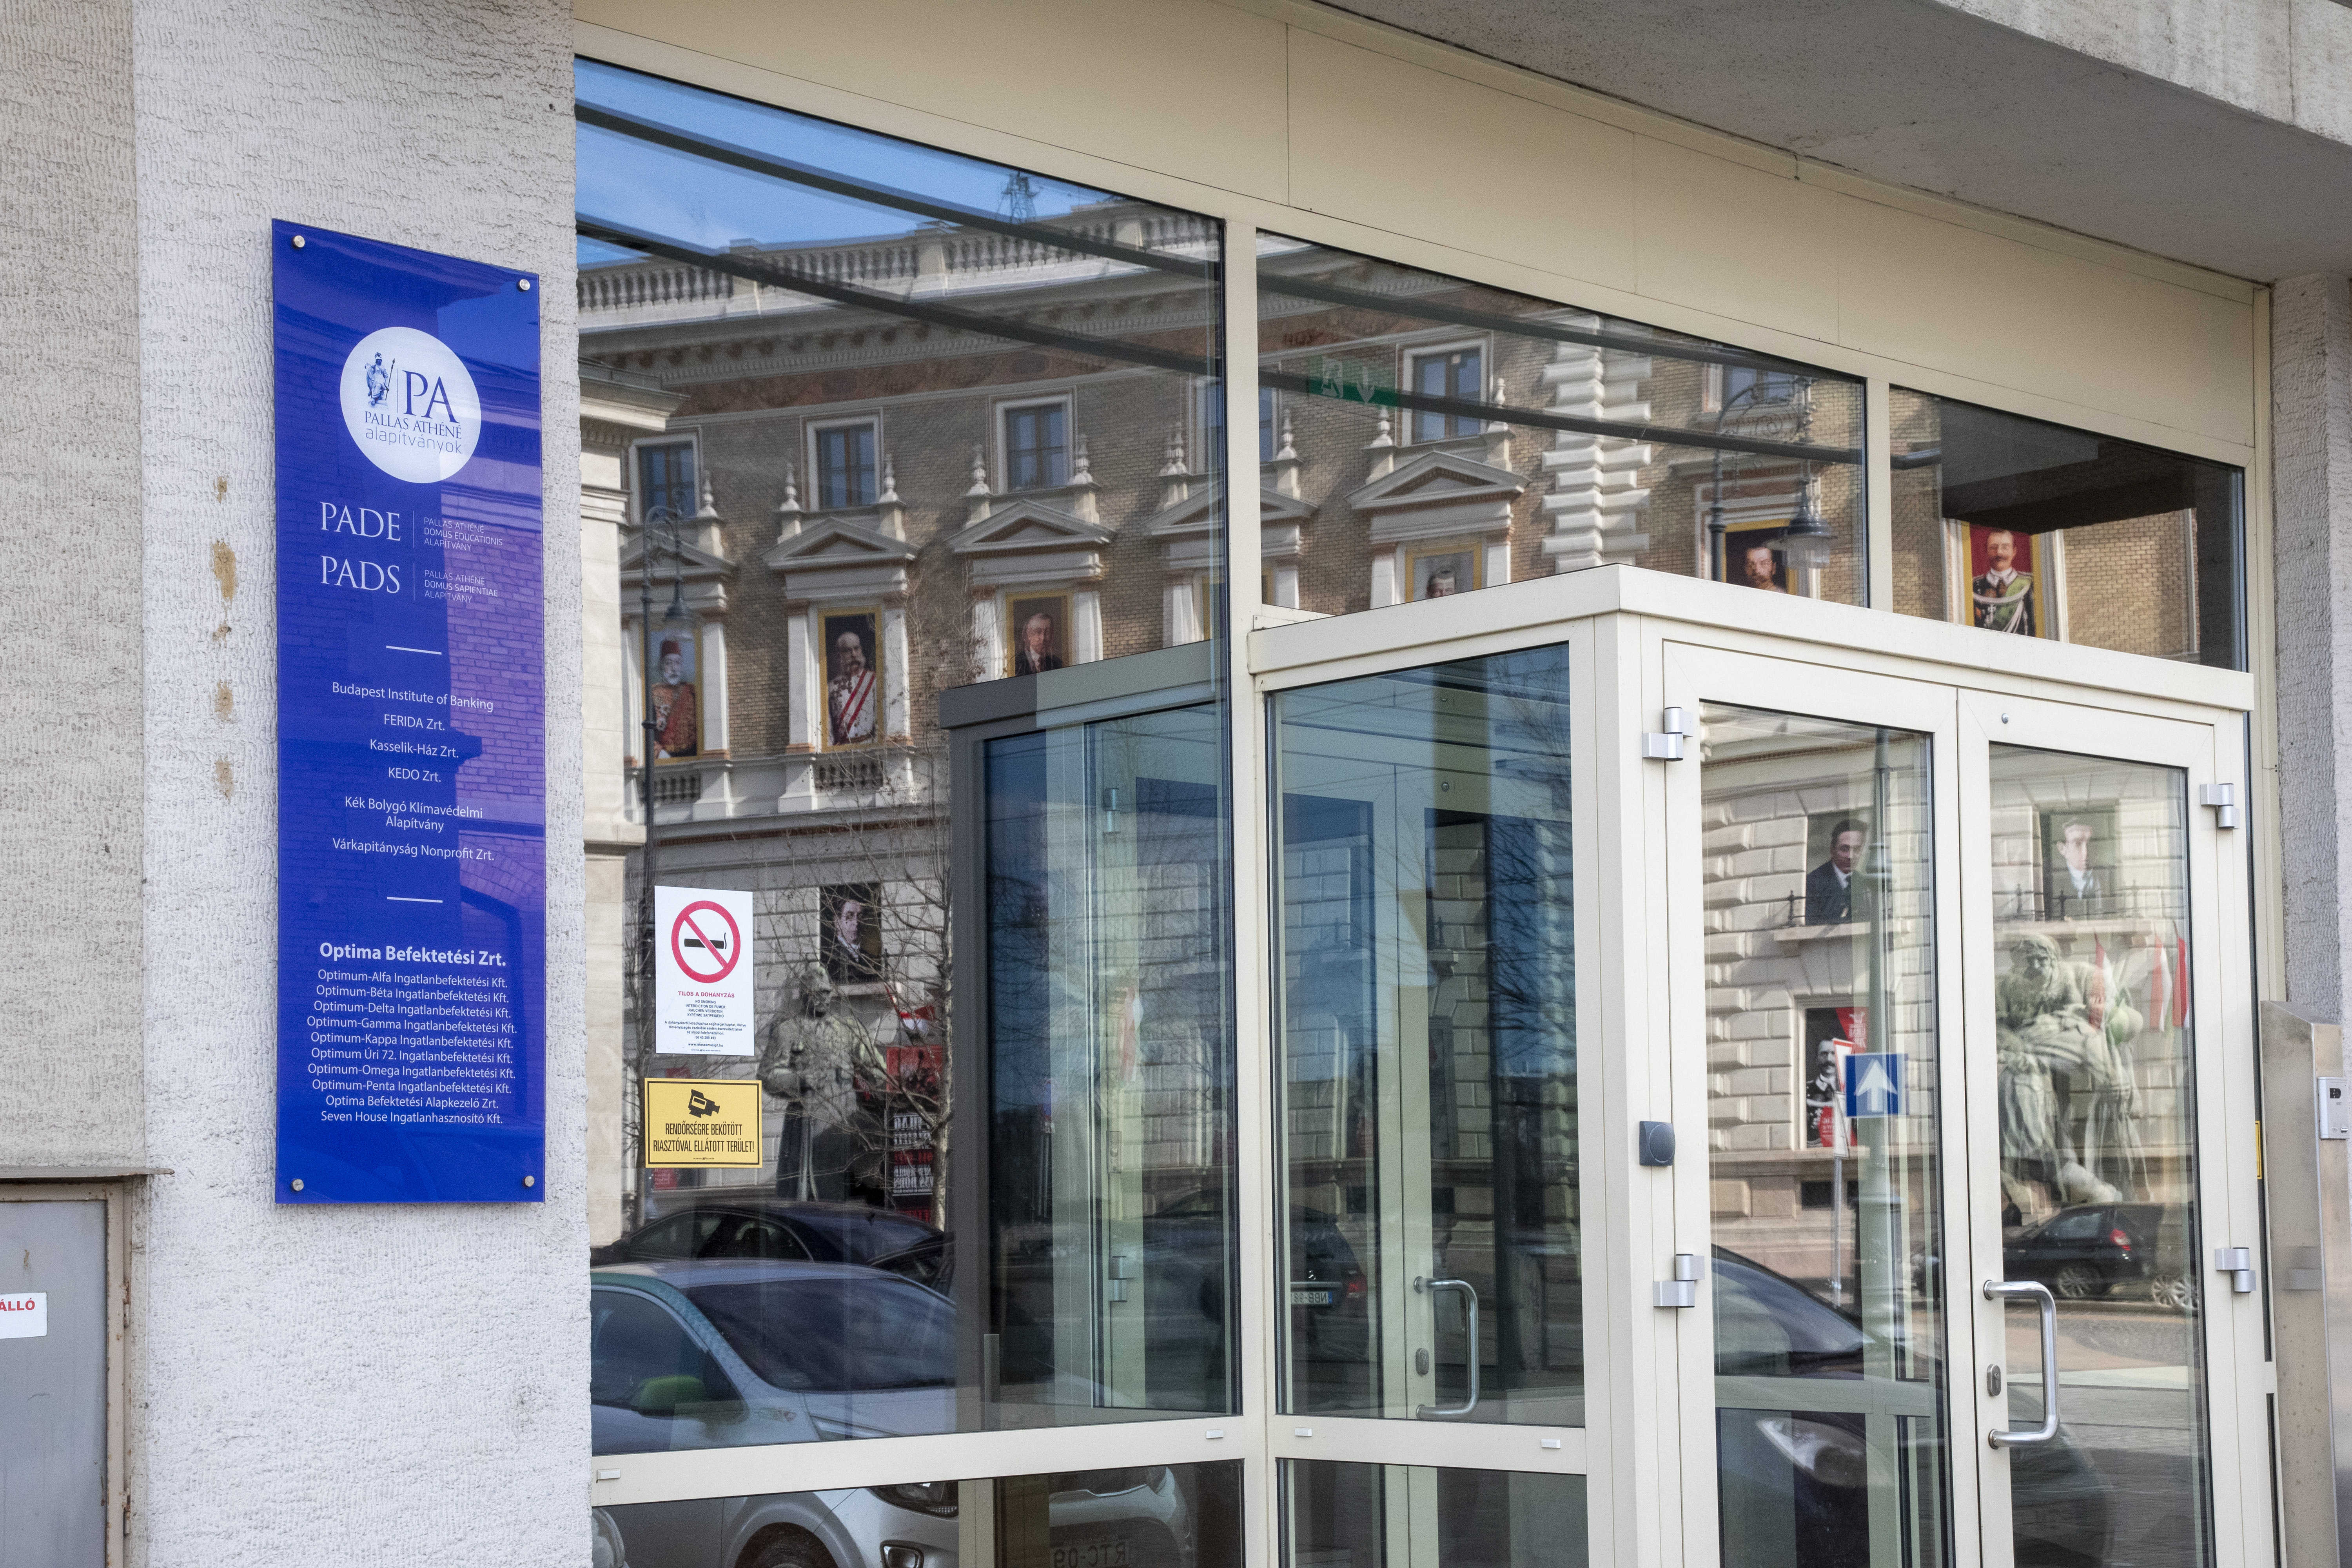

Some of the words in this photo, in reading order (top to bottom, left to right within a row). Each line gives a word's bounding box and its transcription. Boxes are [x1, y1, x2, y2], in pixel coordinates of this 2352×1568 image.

[403, 370, 459, 423] PA
[365, 411, 408, 429] PALLAS
[413, 419, 461, 439] ATHÉNÉ
[366, 425, 461, 454] alapítványok
[320, 502, 400, 541] PADE
[424, 517, 452, 528] PALLAS
[456, 522, 484, 533] ATHÉNÉ
[424, 538, 471, 550] ALAPÍTVÁNY
[425, 528, 452, 538] DOMUS
[455, 532, 503, 546] EDUCATIONIS
[321, 556, 399, 593] PADS
[425, 570, 453, 580] PALLAS
[456, 574, 484, 585] ATHÉNÉ
[425, 580, 452, 590] DOMUS
[455, 584, 497, 597] SAPIENTIAE
[425, 590, 472, 603] ALAPÍTVÁNY
[333, 682, 385, 698] Budapest
[389, 688, 433, 703] Institute
[437, 694, 448, 704] of
[451, 695, 493, 712] Banking
[385, 714, 423, 728] FERIDA
[426, 719, 445, 730] Zrt.
[370, 739, 437, 755] Kasselik-Ház
[441, 746, 458, 758] Zrt.
[389, 767, 419, 780] KEDO
[423, 770, 441, 782] Zrt.
[346, 797, 365, 808] Kék
[369, 799, 406, 813] Bolygó
[410, 802, 482, 818] Klímavédelmi
[386, 816, 444, 833] Alapítvány
[333, 838, 417, 857] Várkapitányság
[421, 845, 473, 859] Nonprofit
[476, 849, 494, 860] Zrt.
[320, 942, 381, 961] Optima
[386, 946, 474, 964] Befektetési
[479, 951, 506, 966] Zrt.
[318, 969, 391, 982] Optimum-Alfa
[395, 973, 488, 986] Ingatlanbefektetési
[492, 978, 507, 987] Kft.
[317, 985, 392, 997] Optimum-Béta
[396, 989, 490, 1002] Ingatlanbefektetési
[494, 993, 508, 1003] Kft.
[314, 1000, 394, 1013] Optimum-Delta
[398, 1004, 492, 1017] Ingatlanbefektetési
[496, 1008, 510, 1018] Kft.
[307, 1016, 401, 1029] Optimum-Gamma
[405, 1020, 498, 1032] Ingatlanbefektetési
[502, 1023, 517, 1033] Kft.
[311, 1032, 397, 1046] Optimum-Kappa
[401, 1035, 494, 1047] Ingatlanbefektetési
[498, 1038, 513, 1048] Kft.
[312, 1048, 361, 1060] Optimum
[365, 1047, 378, 1059] Úri
[382, 1050, 396, 1060] 72.
[400, 1051, 494, 1063] Ingatlanbefektetési
[497, 1053, 512, 1063] Kft.
[308, 1063, 399, 1078] Optimum-Omega
[403, 1066, 497, 1078] Ingatlanbefektetési
[500, 1069, 515, 1078] Kft.
[312, 1079, 395, 1093] Optimum-Penta
[398, 1082, 492, 1093] Ingatlanbefektetési
[496, 1083, 511, 1093] Kft.
[326, 1095, 364, 1107] Optima
[368, 1096, 422, 1106] Befektetési
[426, 1097, 479, 1109] Alapkezelő
[482, 1099, 498, 1108] Zrt.
[321, 1111, 352, 1121] Seven
[356, 1112, 387, 1122] House
[391, 1112, 484, 1124] Ingatlanhasznosító
[487, 1114, 502, 1123] Kft.
[666, 1121, 709, 1135] RENDŐRSÉGRE
[711, 1122, 742, 1135] BEKÖTÖTT
[653, 1138, 692, 1151] RIASZTÓVAL
[695, 1138, 724, 1152] ELLÁTOTT
[726, 1138, 754, 1152] TERÜLET!
